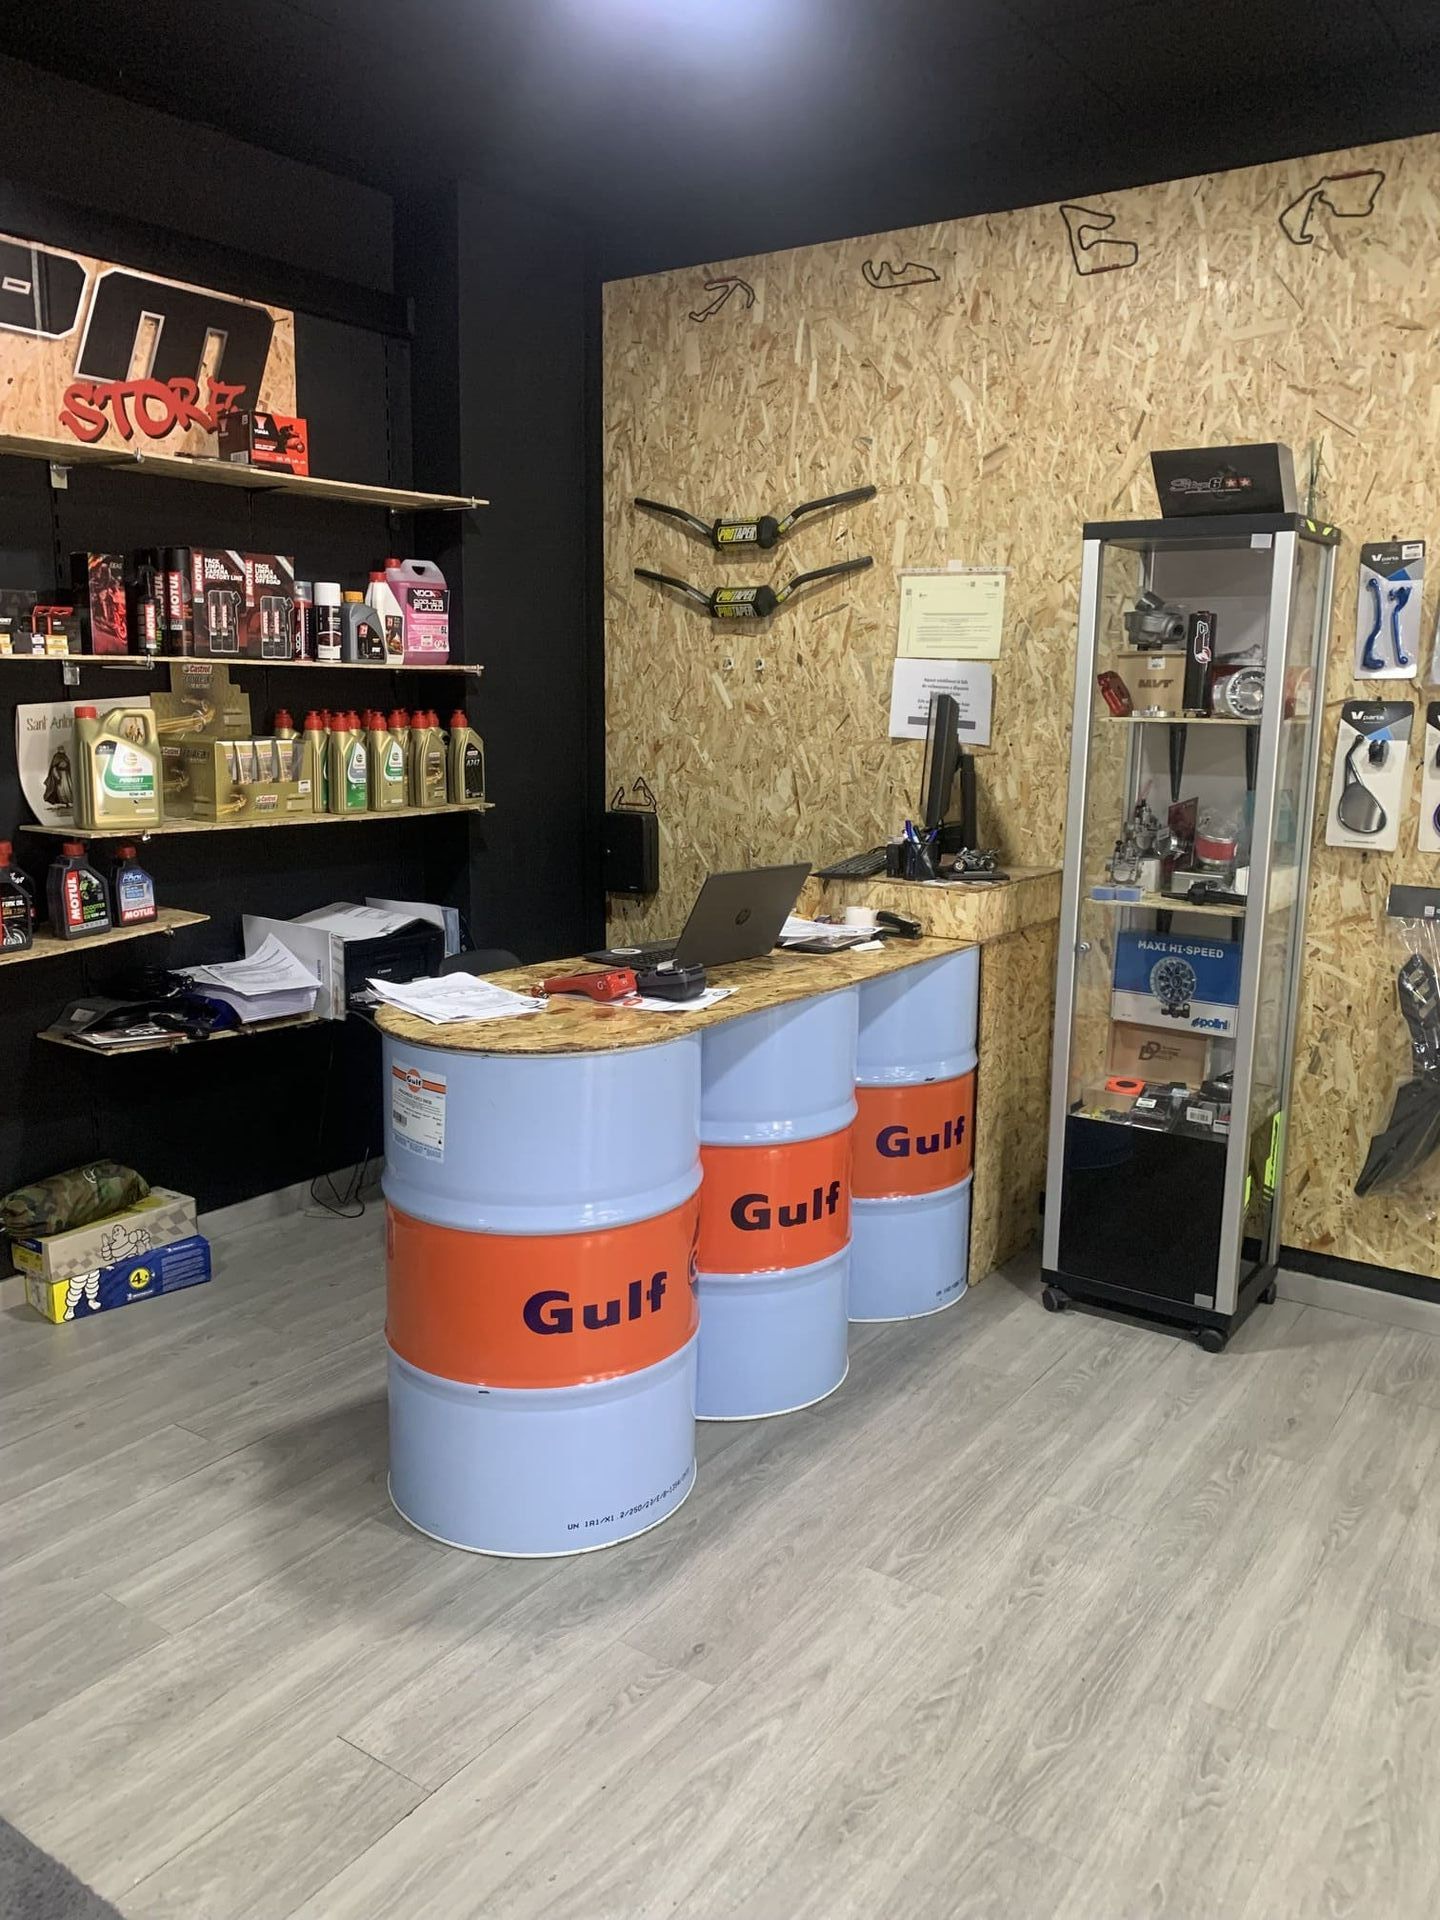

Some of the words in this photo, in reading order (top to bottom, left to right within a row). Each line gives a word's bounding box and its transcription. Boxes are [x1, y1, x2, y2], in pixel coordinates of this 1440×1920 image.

[59, 375, 246, 444] STORE
[194, 554, 204, 593] MOTUL
[246, 560, 255, 596] MOTUL
[168, 574, 180, 617] MOTUL
[147, 606, 156, 639] MOTUL
[188, 664, 212, 674] Castrol
[67, 876, 81, 920] MOTUL
[124, 908, 154, 920] MOTUL
[1138, 940, 1166, 952] MAXI
[406, 1075, 421, 1087] Gulf
[876, 1115, 965, 1158] Gulf
[730, 1180, 841, 1231] Gulf
[523, 1271, 667, 1335] Gulf
